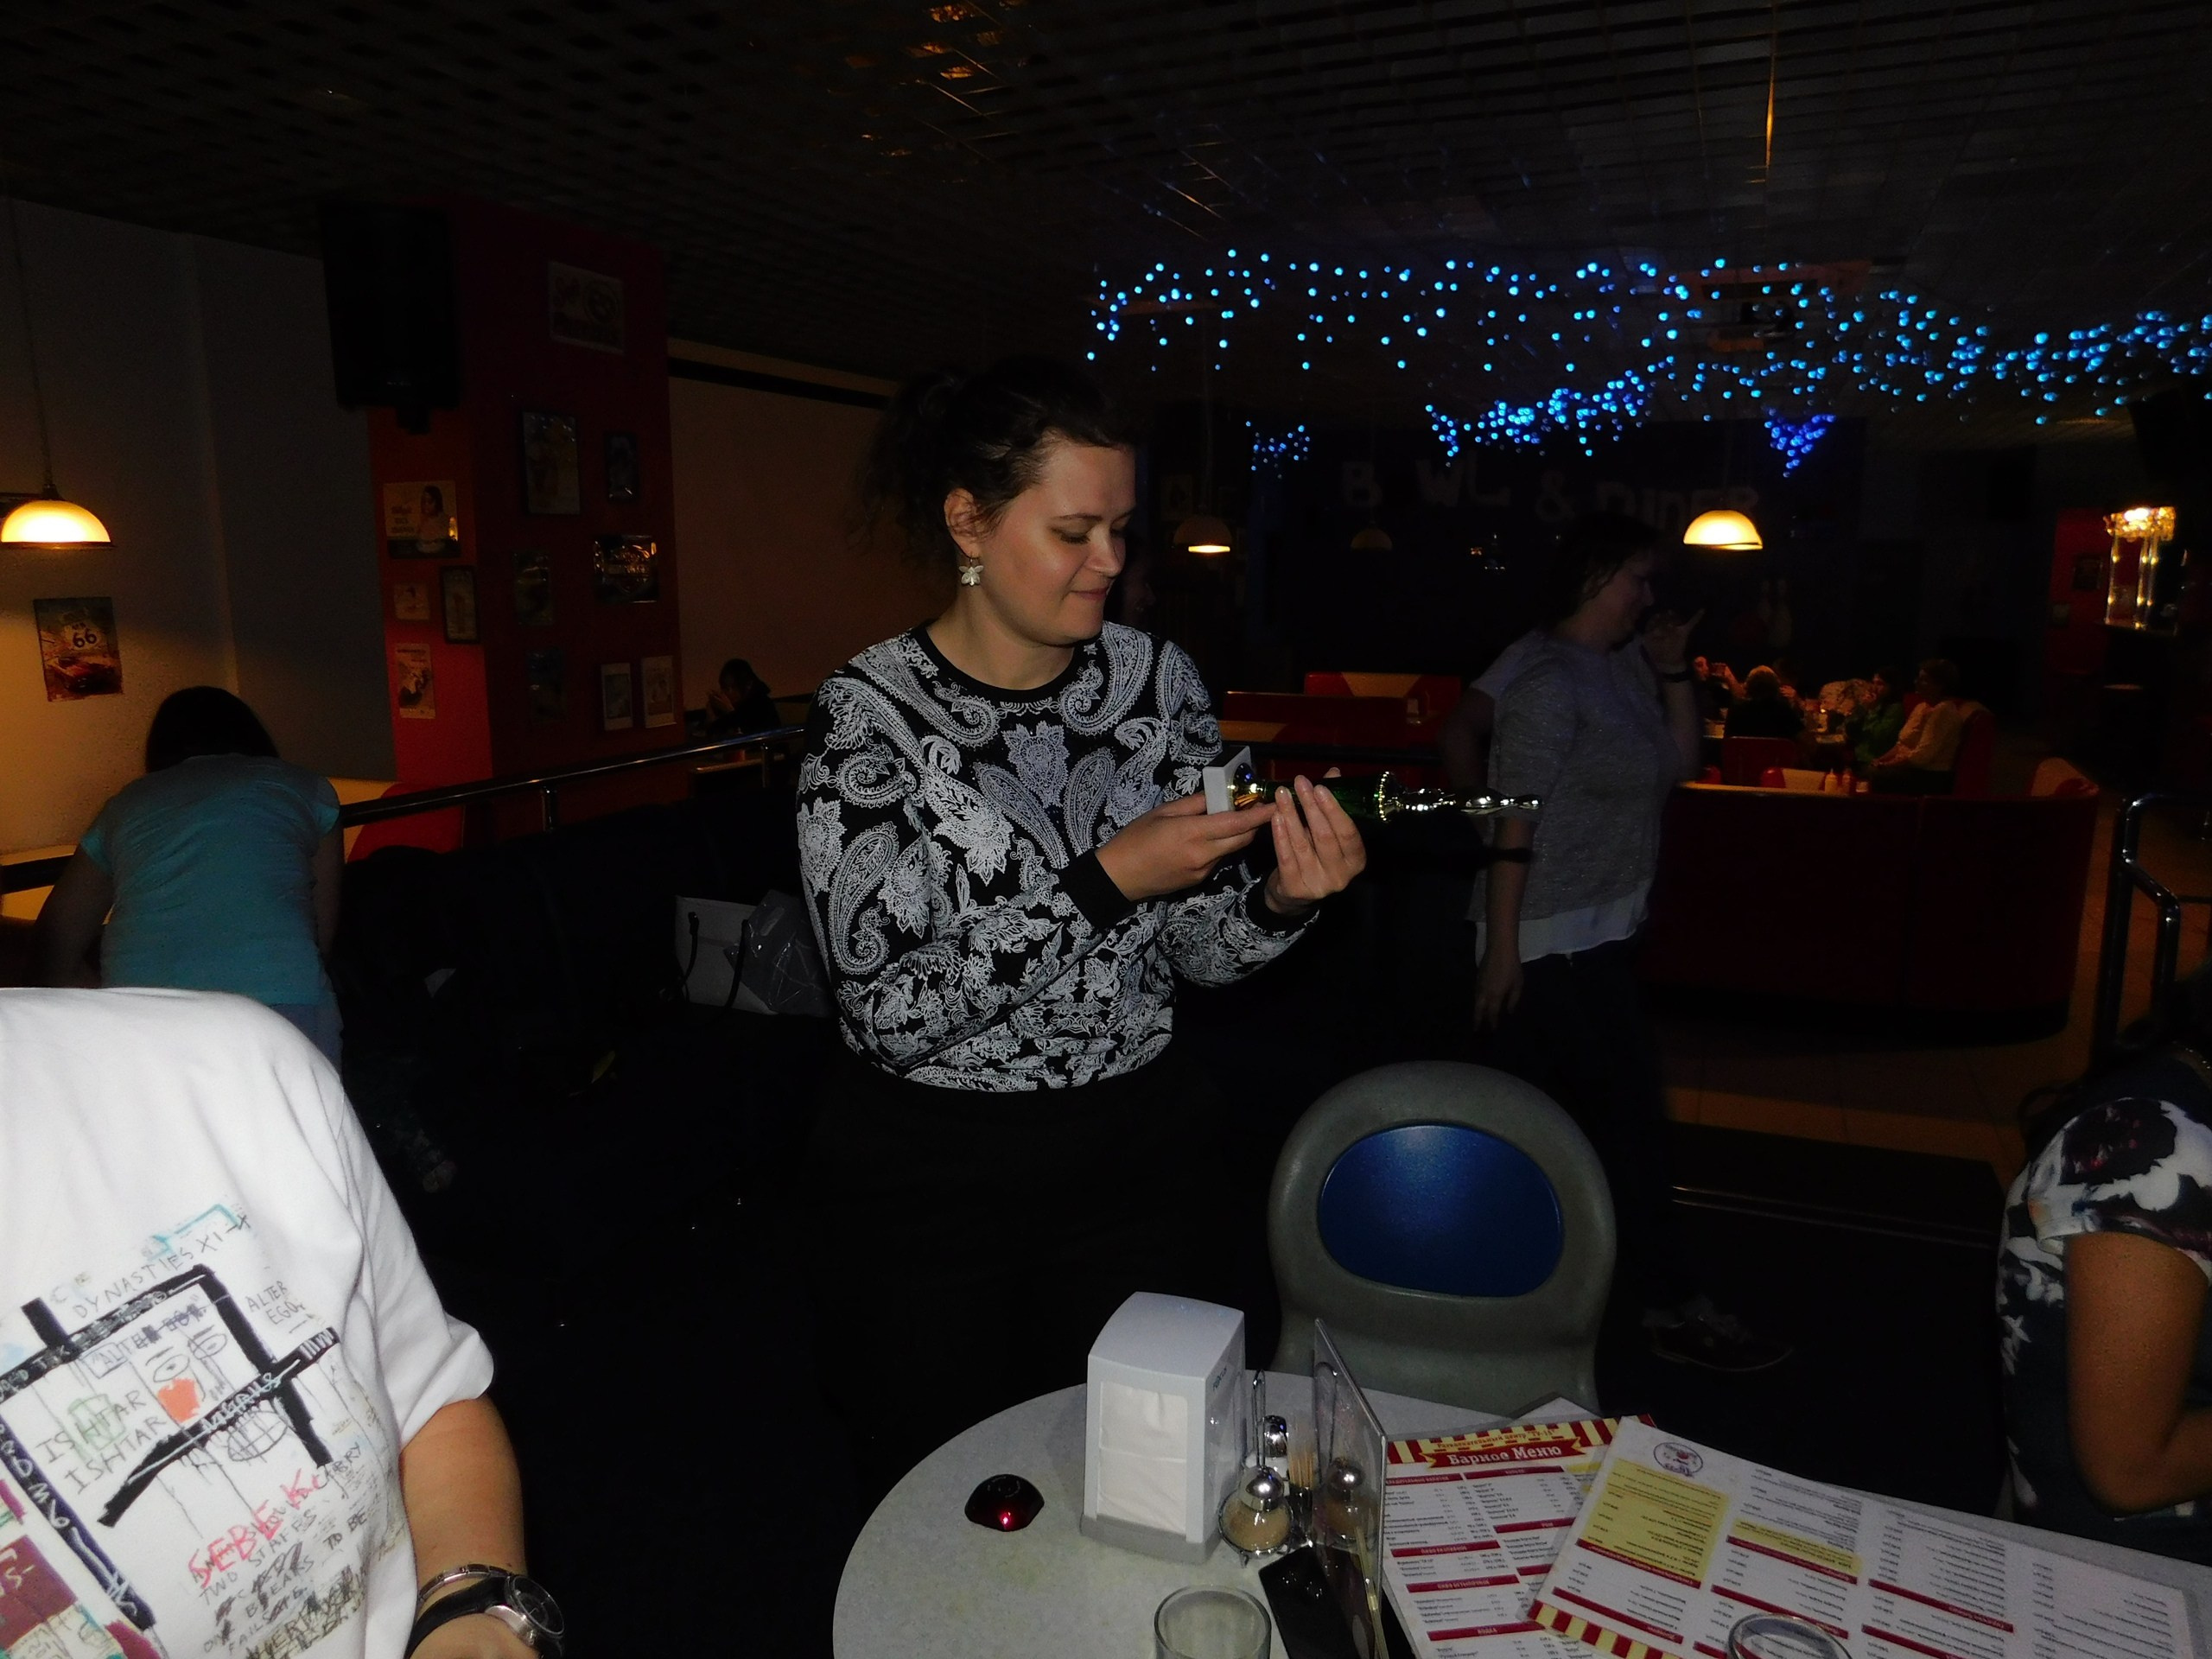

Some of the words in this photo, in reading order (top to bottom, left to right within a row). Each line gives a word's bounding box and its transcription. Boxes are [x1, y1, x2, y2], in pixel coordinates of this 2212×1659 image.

[73, 626, 98, 648] 66
[73, 1247, 194, 1319] DYNASTIES
[245, 1280, 289, 1313] ALTER
[35, 1389, 148, 1464] ISHTAR
[63, 1414, 170, 1494] ISHTAR
[1446, 1452, 1510, 1467] Барное
[1513, 1445, 1562, 1460] Меню
[199, 1572, 238, 1606] TWO
